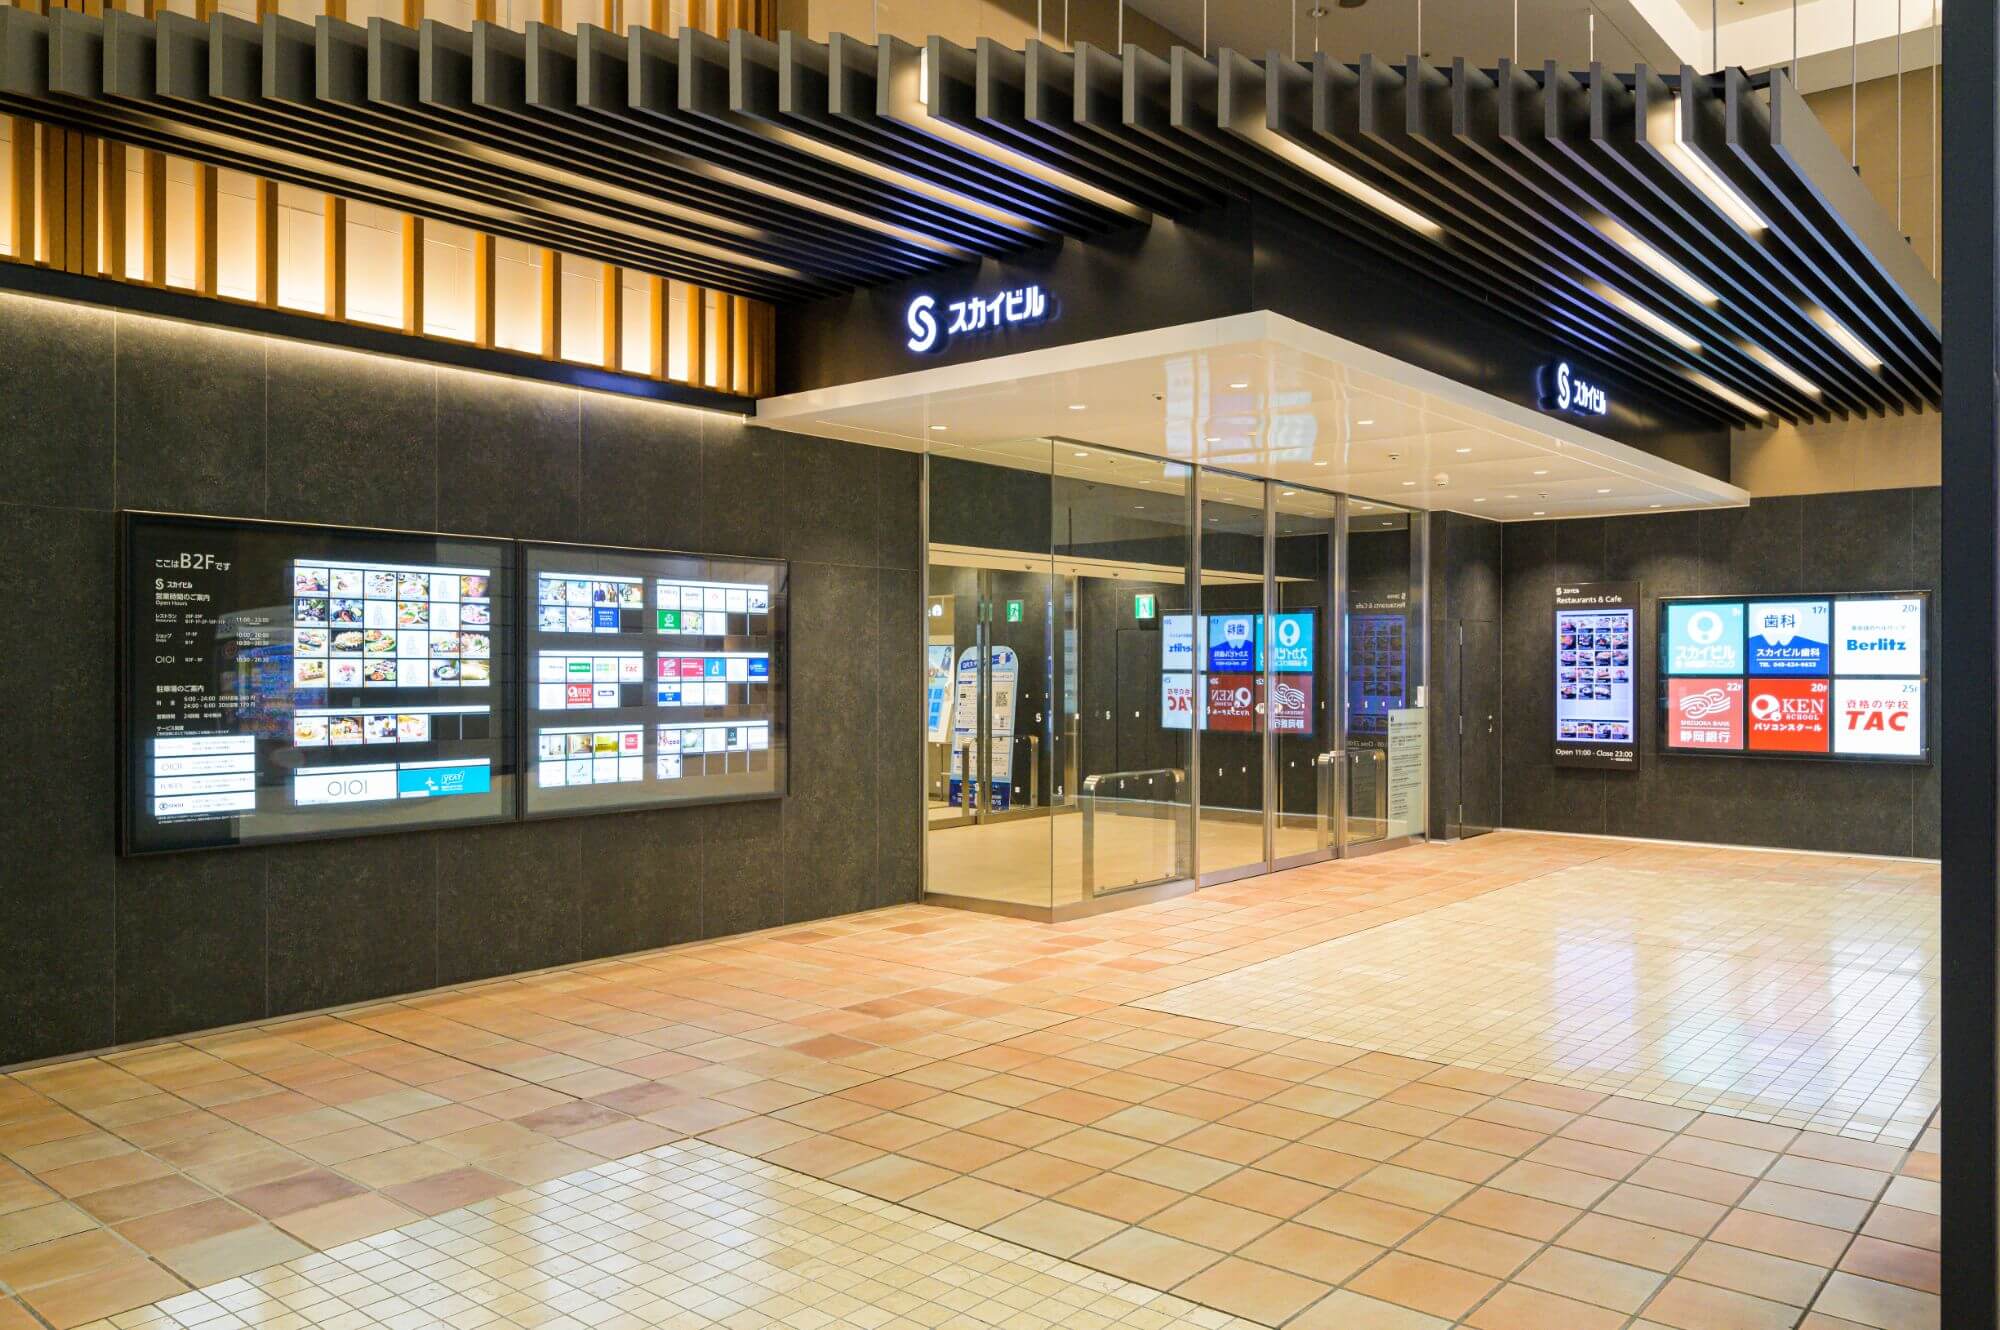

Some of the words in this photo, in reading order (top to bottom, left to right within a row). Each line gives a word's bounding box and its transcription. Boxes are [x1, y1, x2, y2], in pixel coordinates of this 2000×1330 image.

[949, 286, 1045, 334] スカイビル
[1574, 380, 1606, 414] スカイビル
[1556, 596, 1597, 604] Restaurants
[1605, 595, 1622, 603] Cafe
[1764, 613, 1796, 629] 歯科
[1846, 638, 1907, 652] Berlitz
[1677, 645, 1736, 660] スカイビル
[1756, 648, 1820, 657] スカイビル歯科
[1782, 698, 1824, 713] KEN
[1846, 699, 1910, 709] 資格の学校
[1786, 713, 1820, 721] SCHOOL
[1846, 711, 1909, 732] TAC
[1754, 722, 1823, 732] パソコンスクール
[1680, 730, 1730, 743] 静岡銀行
[1596, 749, 1614, 757] Close
